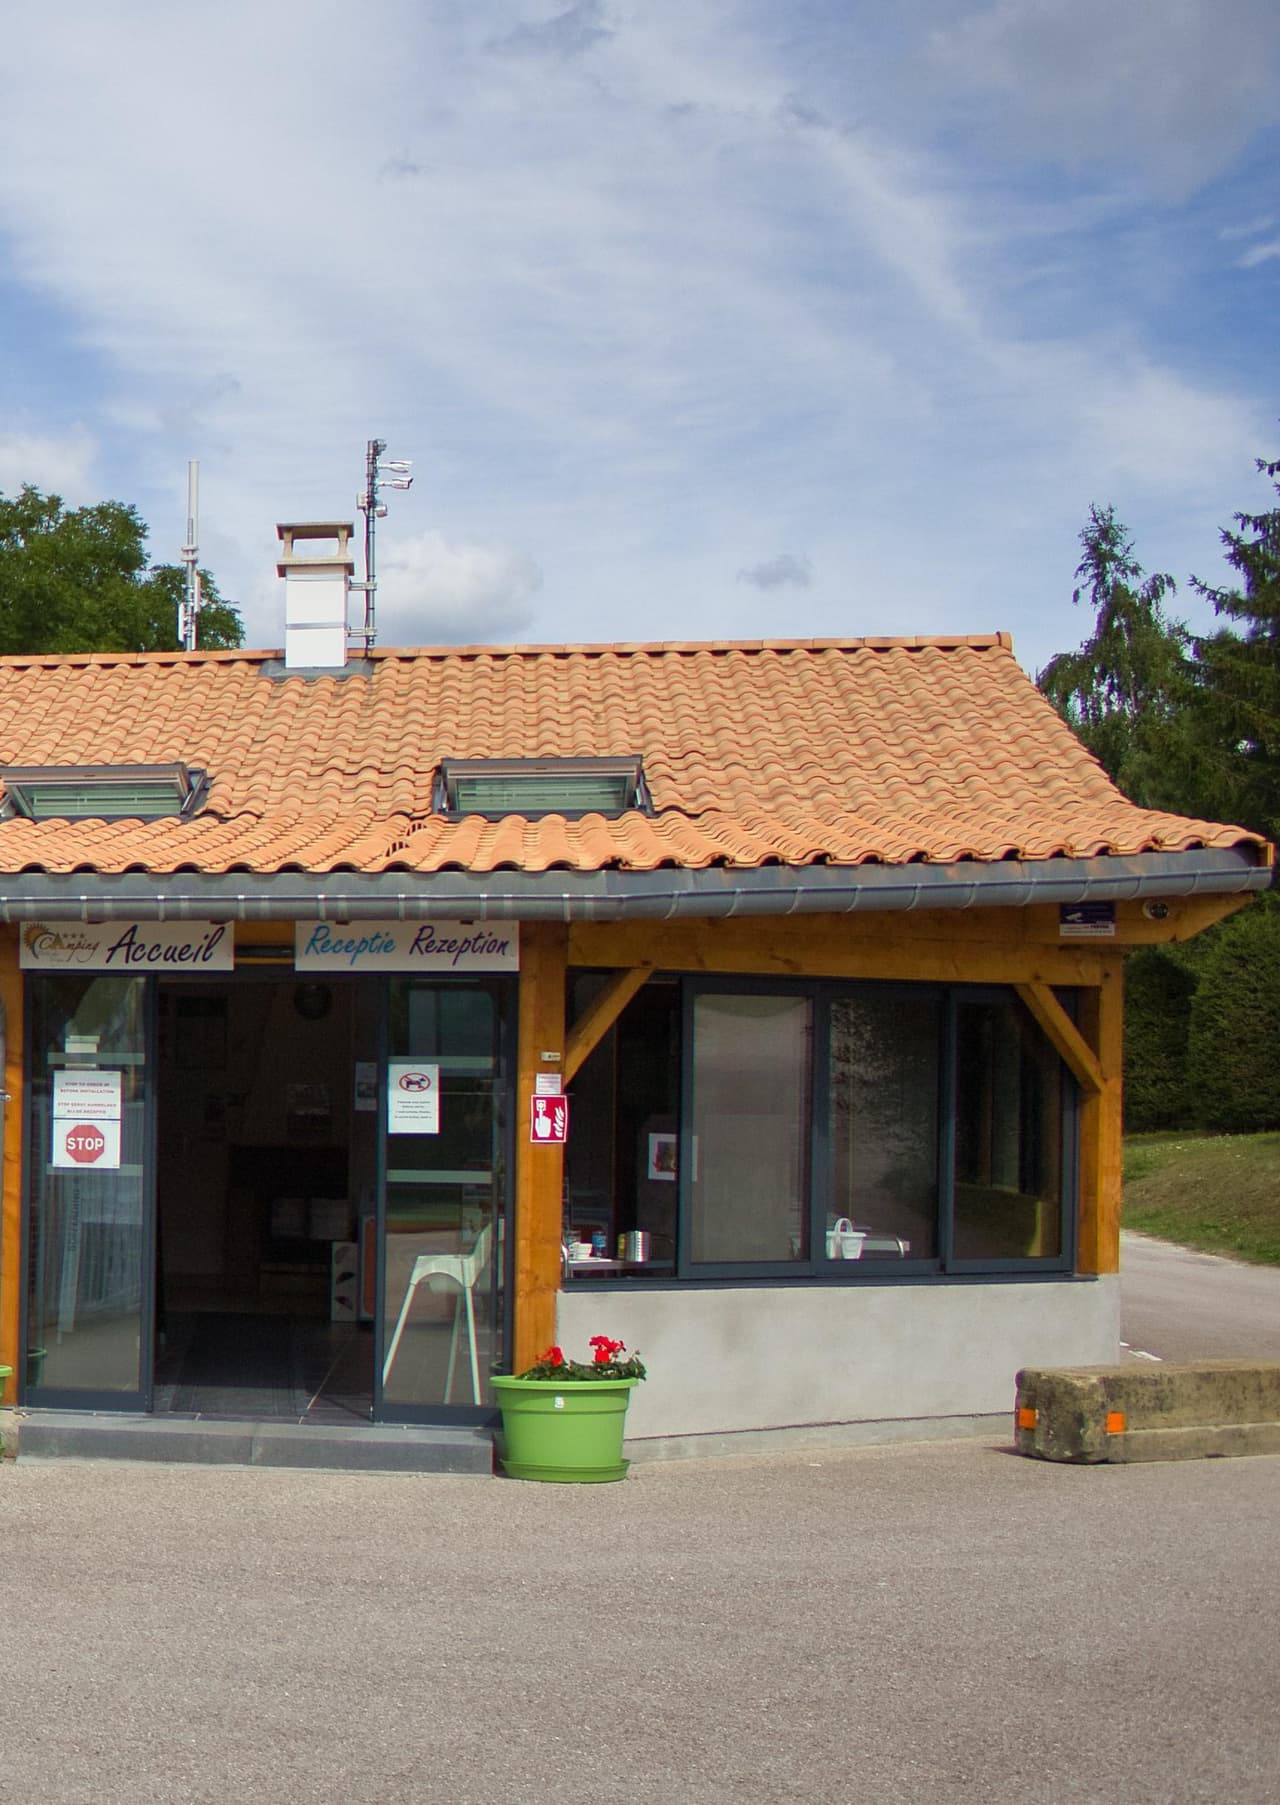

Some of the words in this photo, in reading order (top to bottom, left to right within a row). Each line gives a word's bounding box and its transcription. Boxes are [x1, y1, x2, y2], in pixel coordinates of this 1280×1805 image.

[105, 924, 226, 964] Accueil
[304, 925, 396, 966] Receptie
[409, 925, 510, 966] Rezeption
[67, 1137, 104, 1151] STOP
